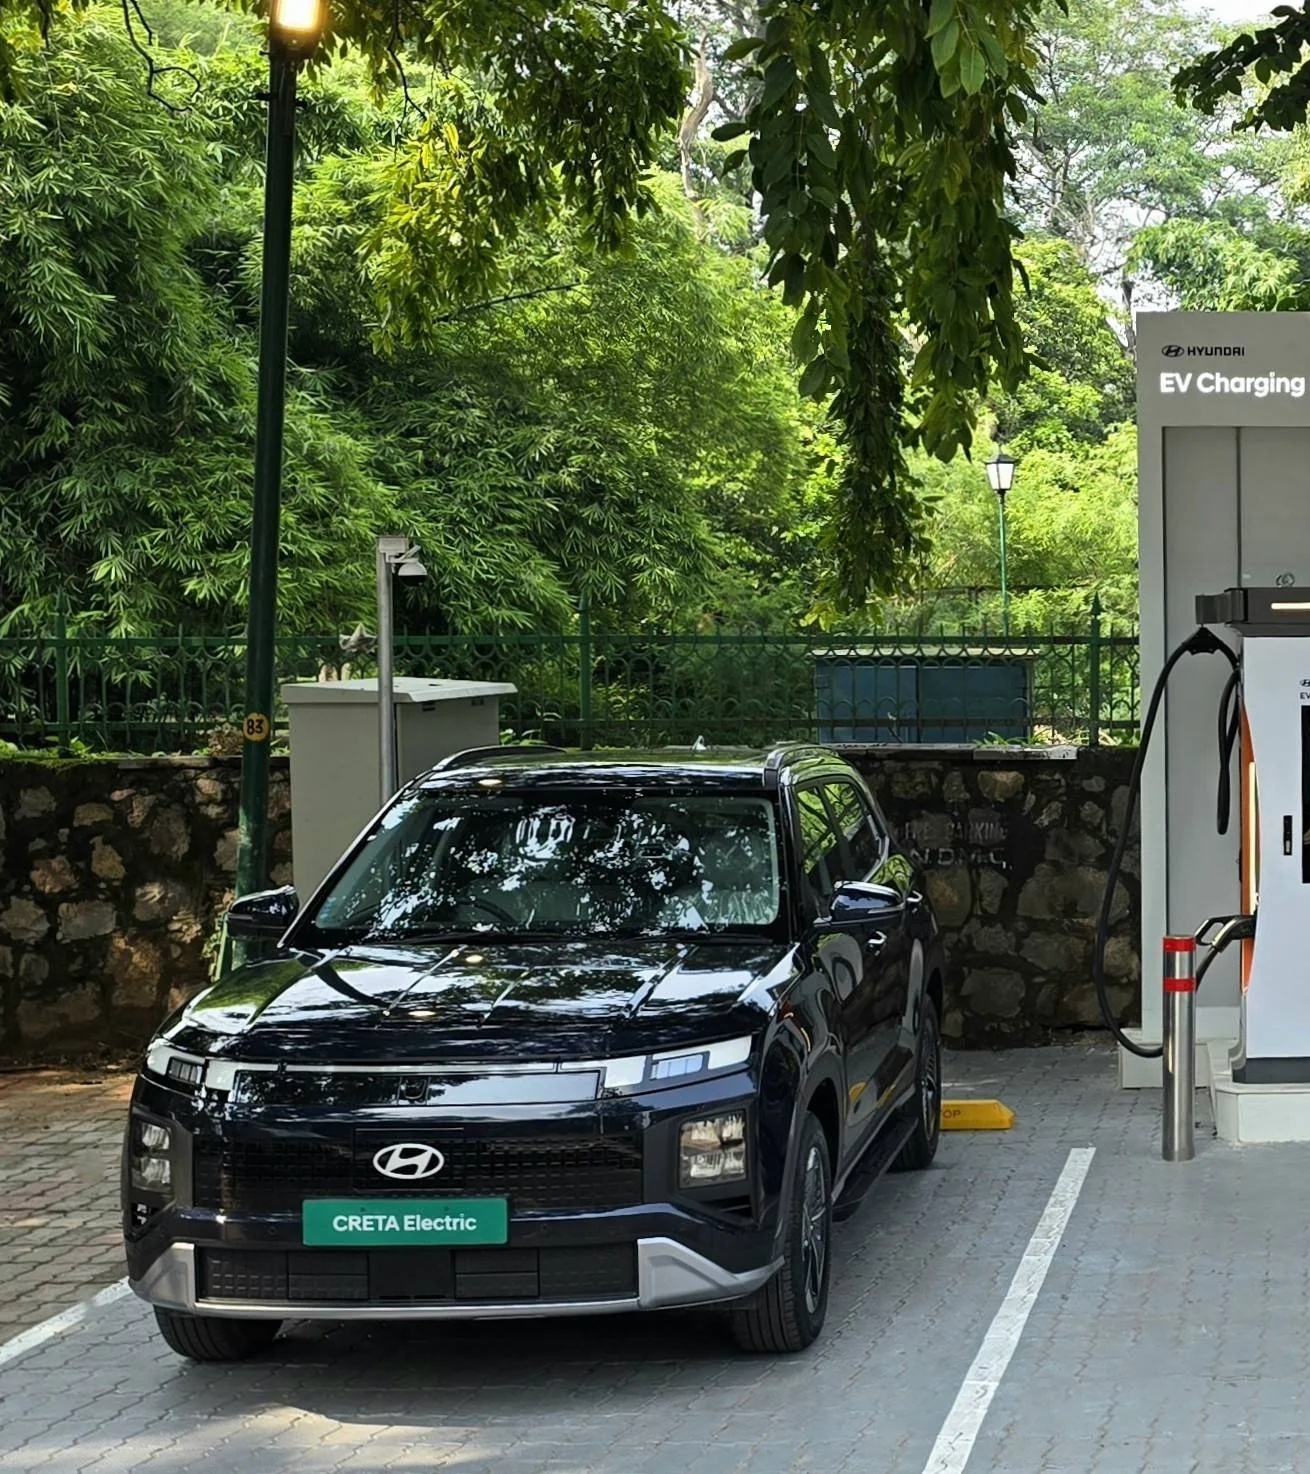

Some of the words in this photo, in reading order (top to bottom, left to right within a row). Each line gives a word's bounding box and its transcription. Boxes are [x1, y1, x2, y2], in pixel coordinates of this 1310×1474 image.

[1187, 346, 1245, 357] HYUNDAI
[1160, 372, 1193, 394] EV
[1197, 371, 1305, 398] Charging
[1300, 692, 1310, 700] EV
[247, 719, 264, 735] 83
[332, 1215, 399, 1232] CRETA
[404, 1214, 477, 1231] Electric
